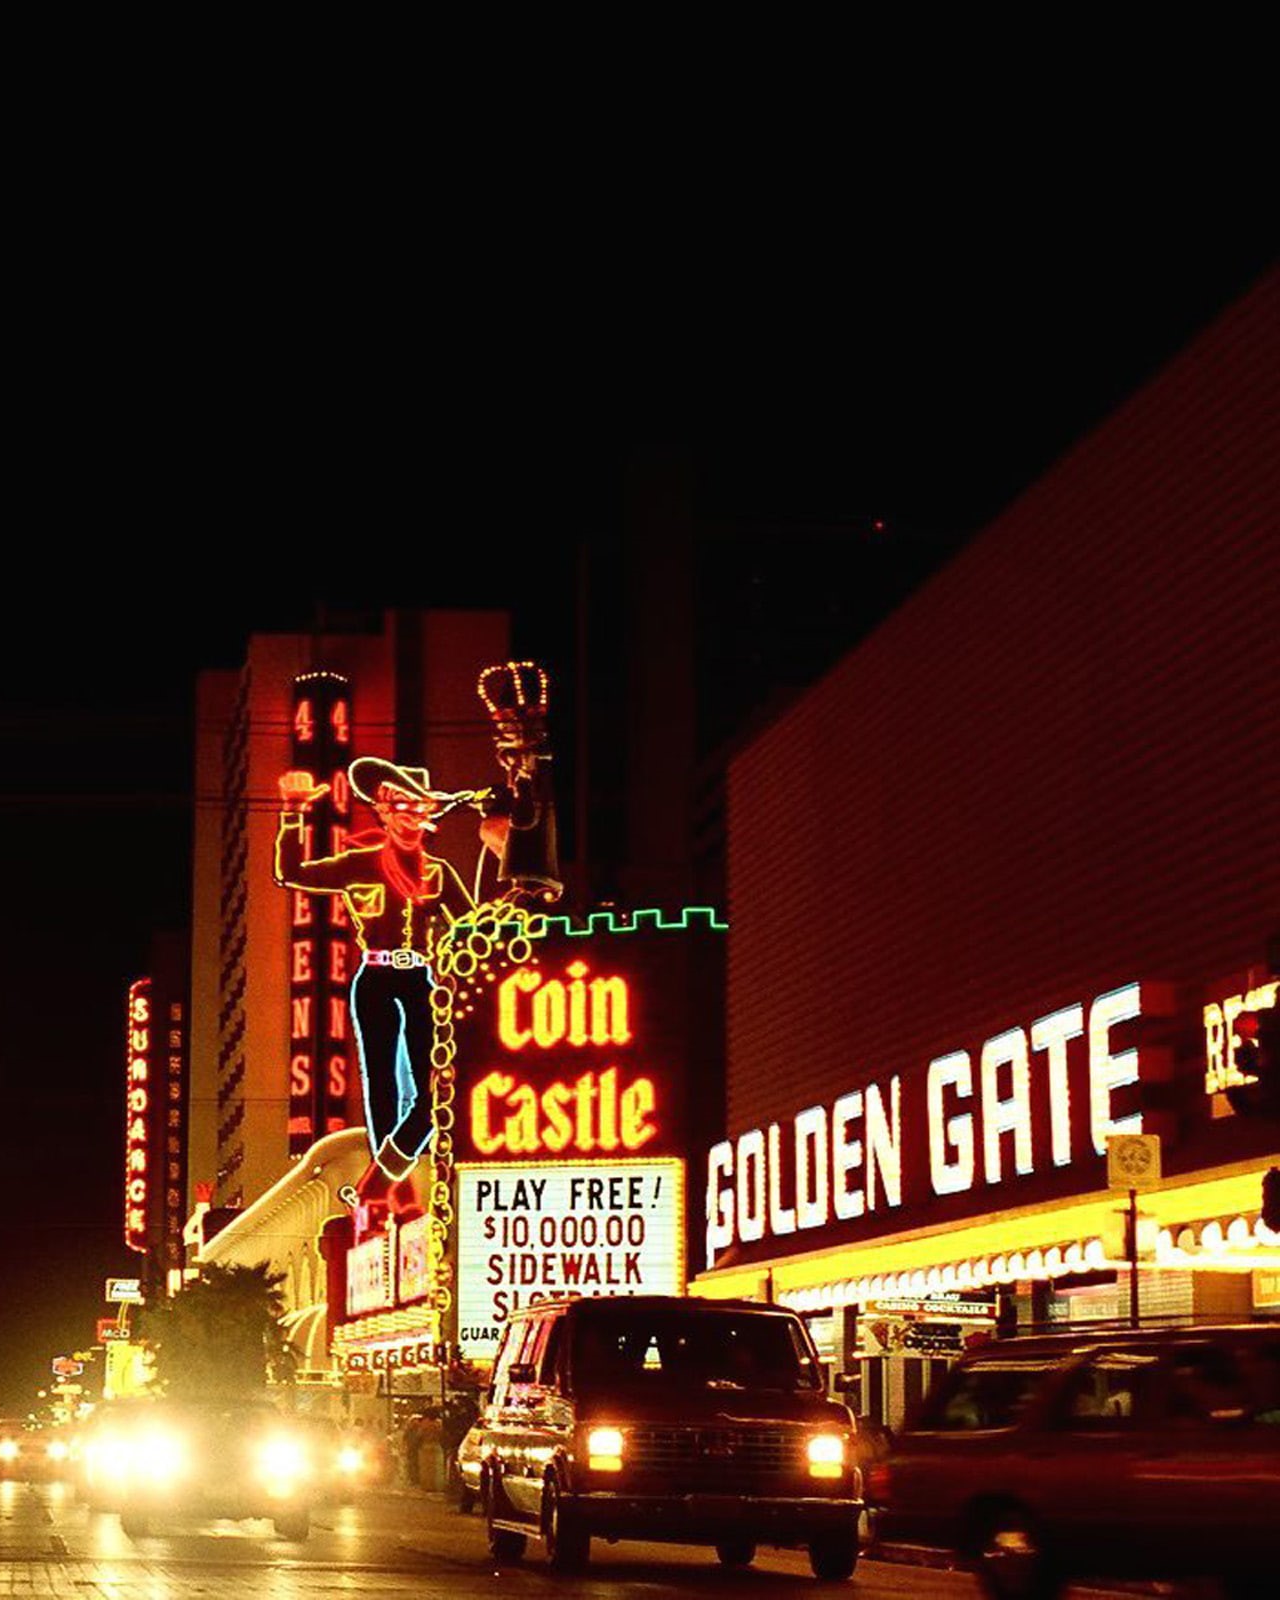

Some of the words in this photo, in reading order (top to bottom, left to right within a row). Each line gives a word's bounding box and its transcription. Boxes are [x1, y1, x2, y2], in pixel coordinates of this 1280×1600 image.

[497, 960, 631, 1050] Coin
[129, 997, 149, 1233] SUNDANCE
[470, 1067, 657, 1156] Castle
[706, 1075, 901, 1252] GOLDEN
[926, 981, 1142, 1197] GATE
[476, 1178, 546, 1212] PLAY
[484, 1215, 644, 1250] $10,000.00
[487, 1252, 642, 1286] SIDEWALK
[460, 1327, 500, 1342] GUAR
